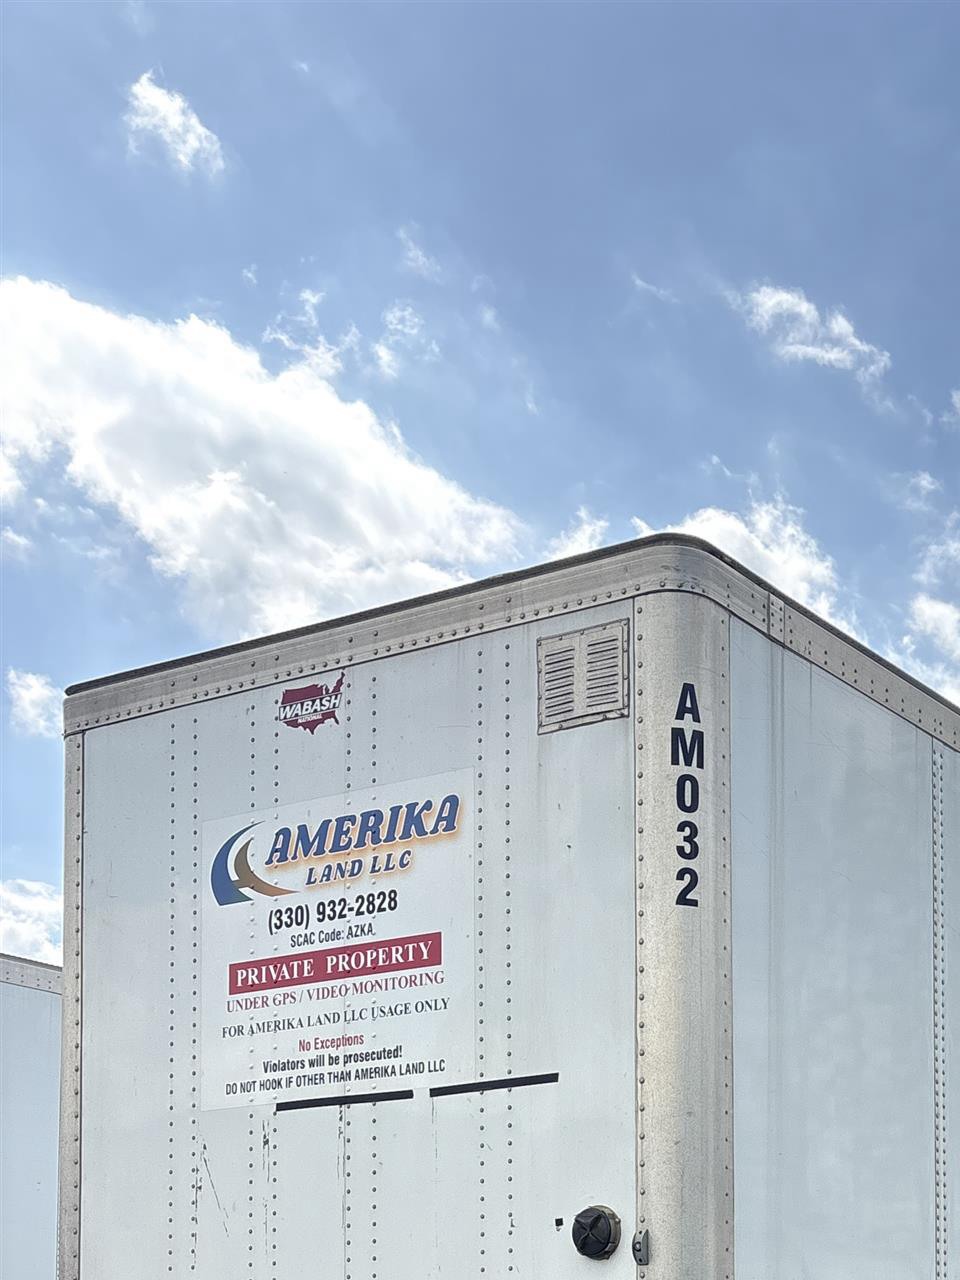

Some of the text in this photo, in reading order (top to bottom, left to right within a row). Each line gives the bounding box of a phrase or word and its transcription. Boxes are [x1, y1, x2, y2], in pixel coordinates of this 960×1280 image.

[280, 694, 341, 720] WABASH
[671, 682, 704, 907] AM032
[265, 794, 459, 865] AMERIKA
[306, 850, 411, 885] LAND LLC
[269, 890, 397, 934] (330) 932-2828
[291, 923, 373, 947] SCAC Code: AZKA
[236, 941, 432, 986] PRIVATE PROPERTY
[227, 971, 444, 1013] UNDER GPS / VIDEO MONITORING
[222, 997, 449, 1038] FOR AMERIKA LAND LLC USAGE ONLY
[263, 1045, 402, 1073] Violators will be prosecuted!
[299, 1034, 364, 1052] No Exceptions
[226, 1059, 445, 1095] DO NOT HOOK IF OTHER THAN AMERIKA LAND LLC
